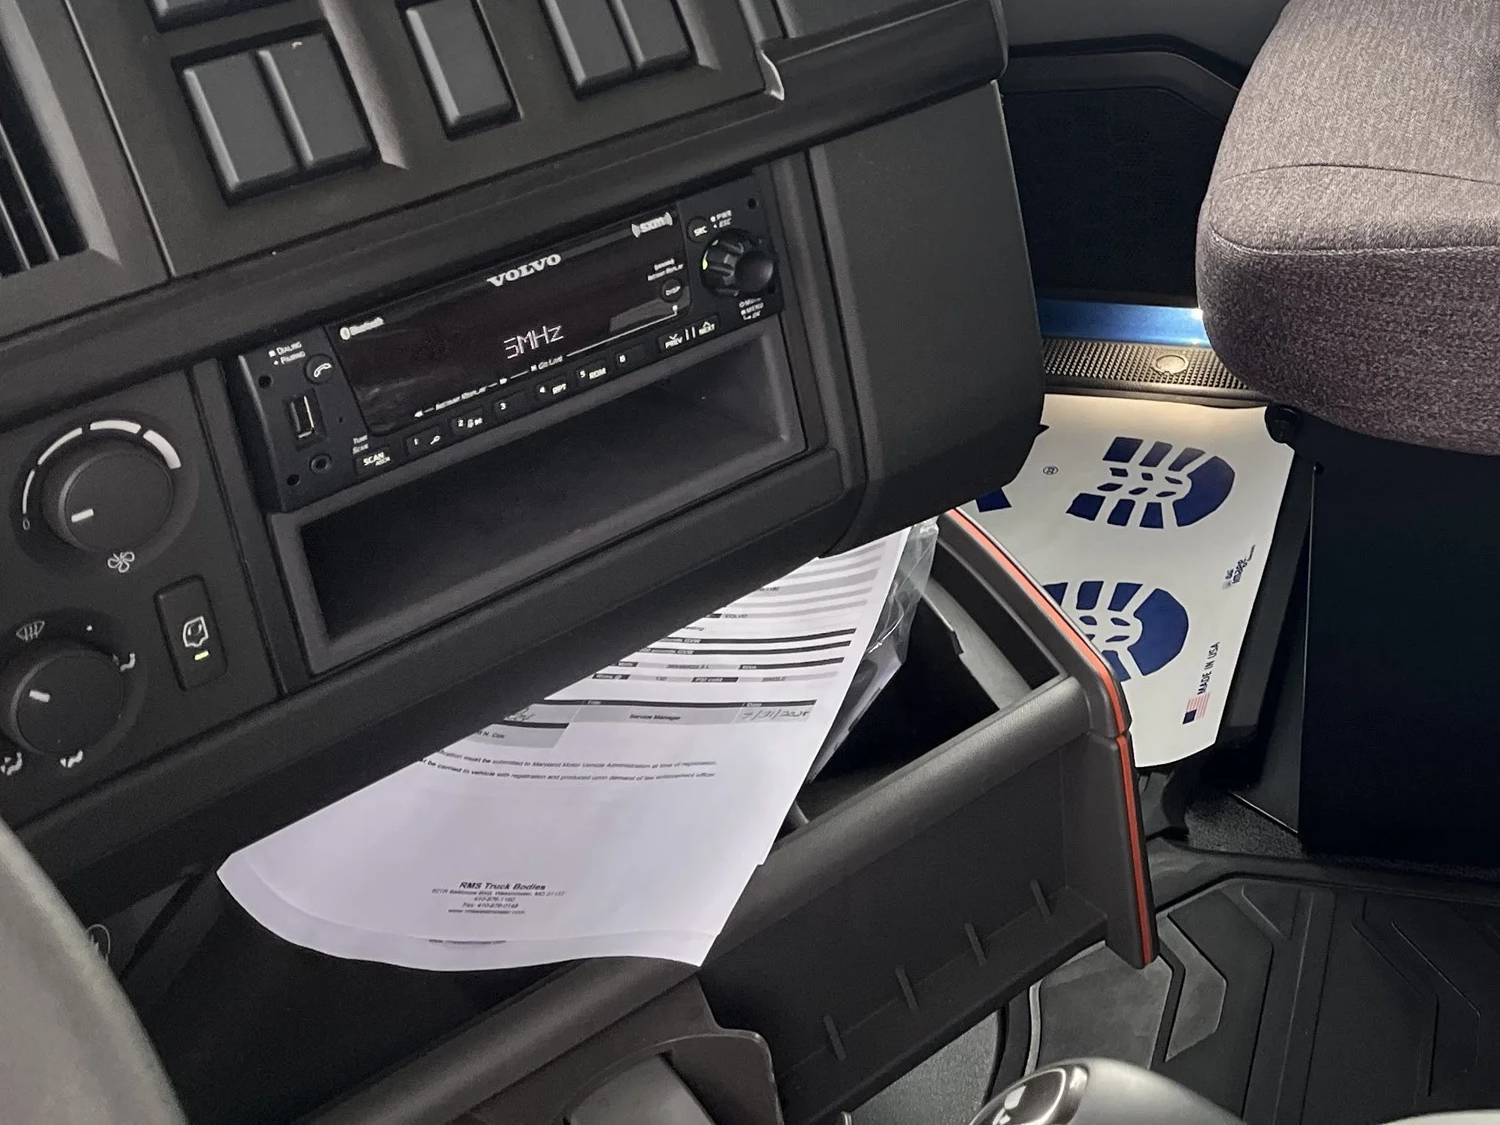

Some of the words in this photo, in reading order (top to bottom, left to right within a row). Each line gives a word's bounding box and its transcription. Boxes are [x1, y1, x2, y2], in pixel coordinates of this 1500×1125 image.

[487, 254, 562, 287] VOLVO
[579, 370, 586, 378] 5
[500, 402, 507, 411] 3
[363, 451, 385, 466] SCAN
[1208, 641, 1221, 660] USA
[1205, 659, 1215, 671] IN
[1197, 671, 1212, 695] MADE
[459, 881, 481, 889] RMS
[485, 882, 510, 890] Truck
[513, 883, 547, 891] Bodies
